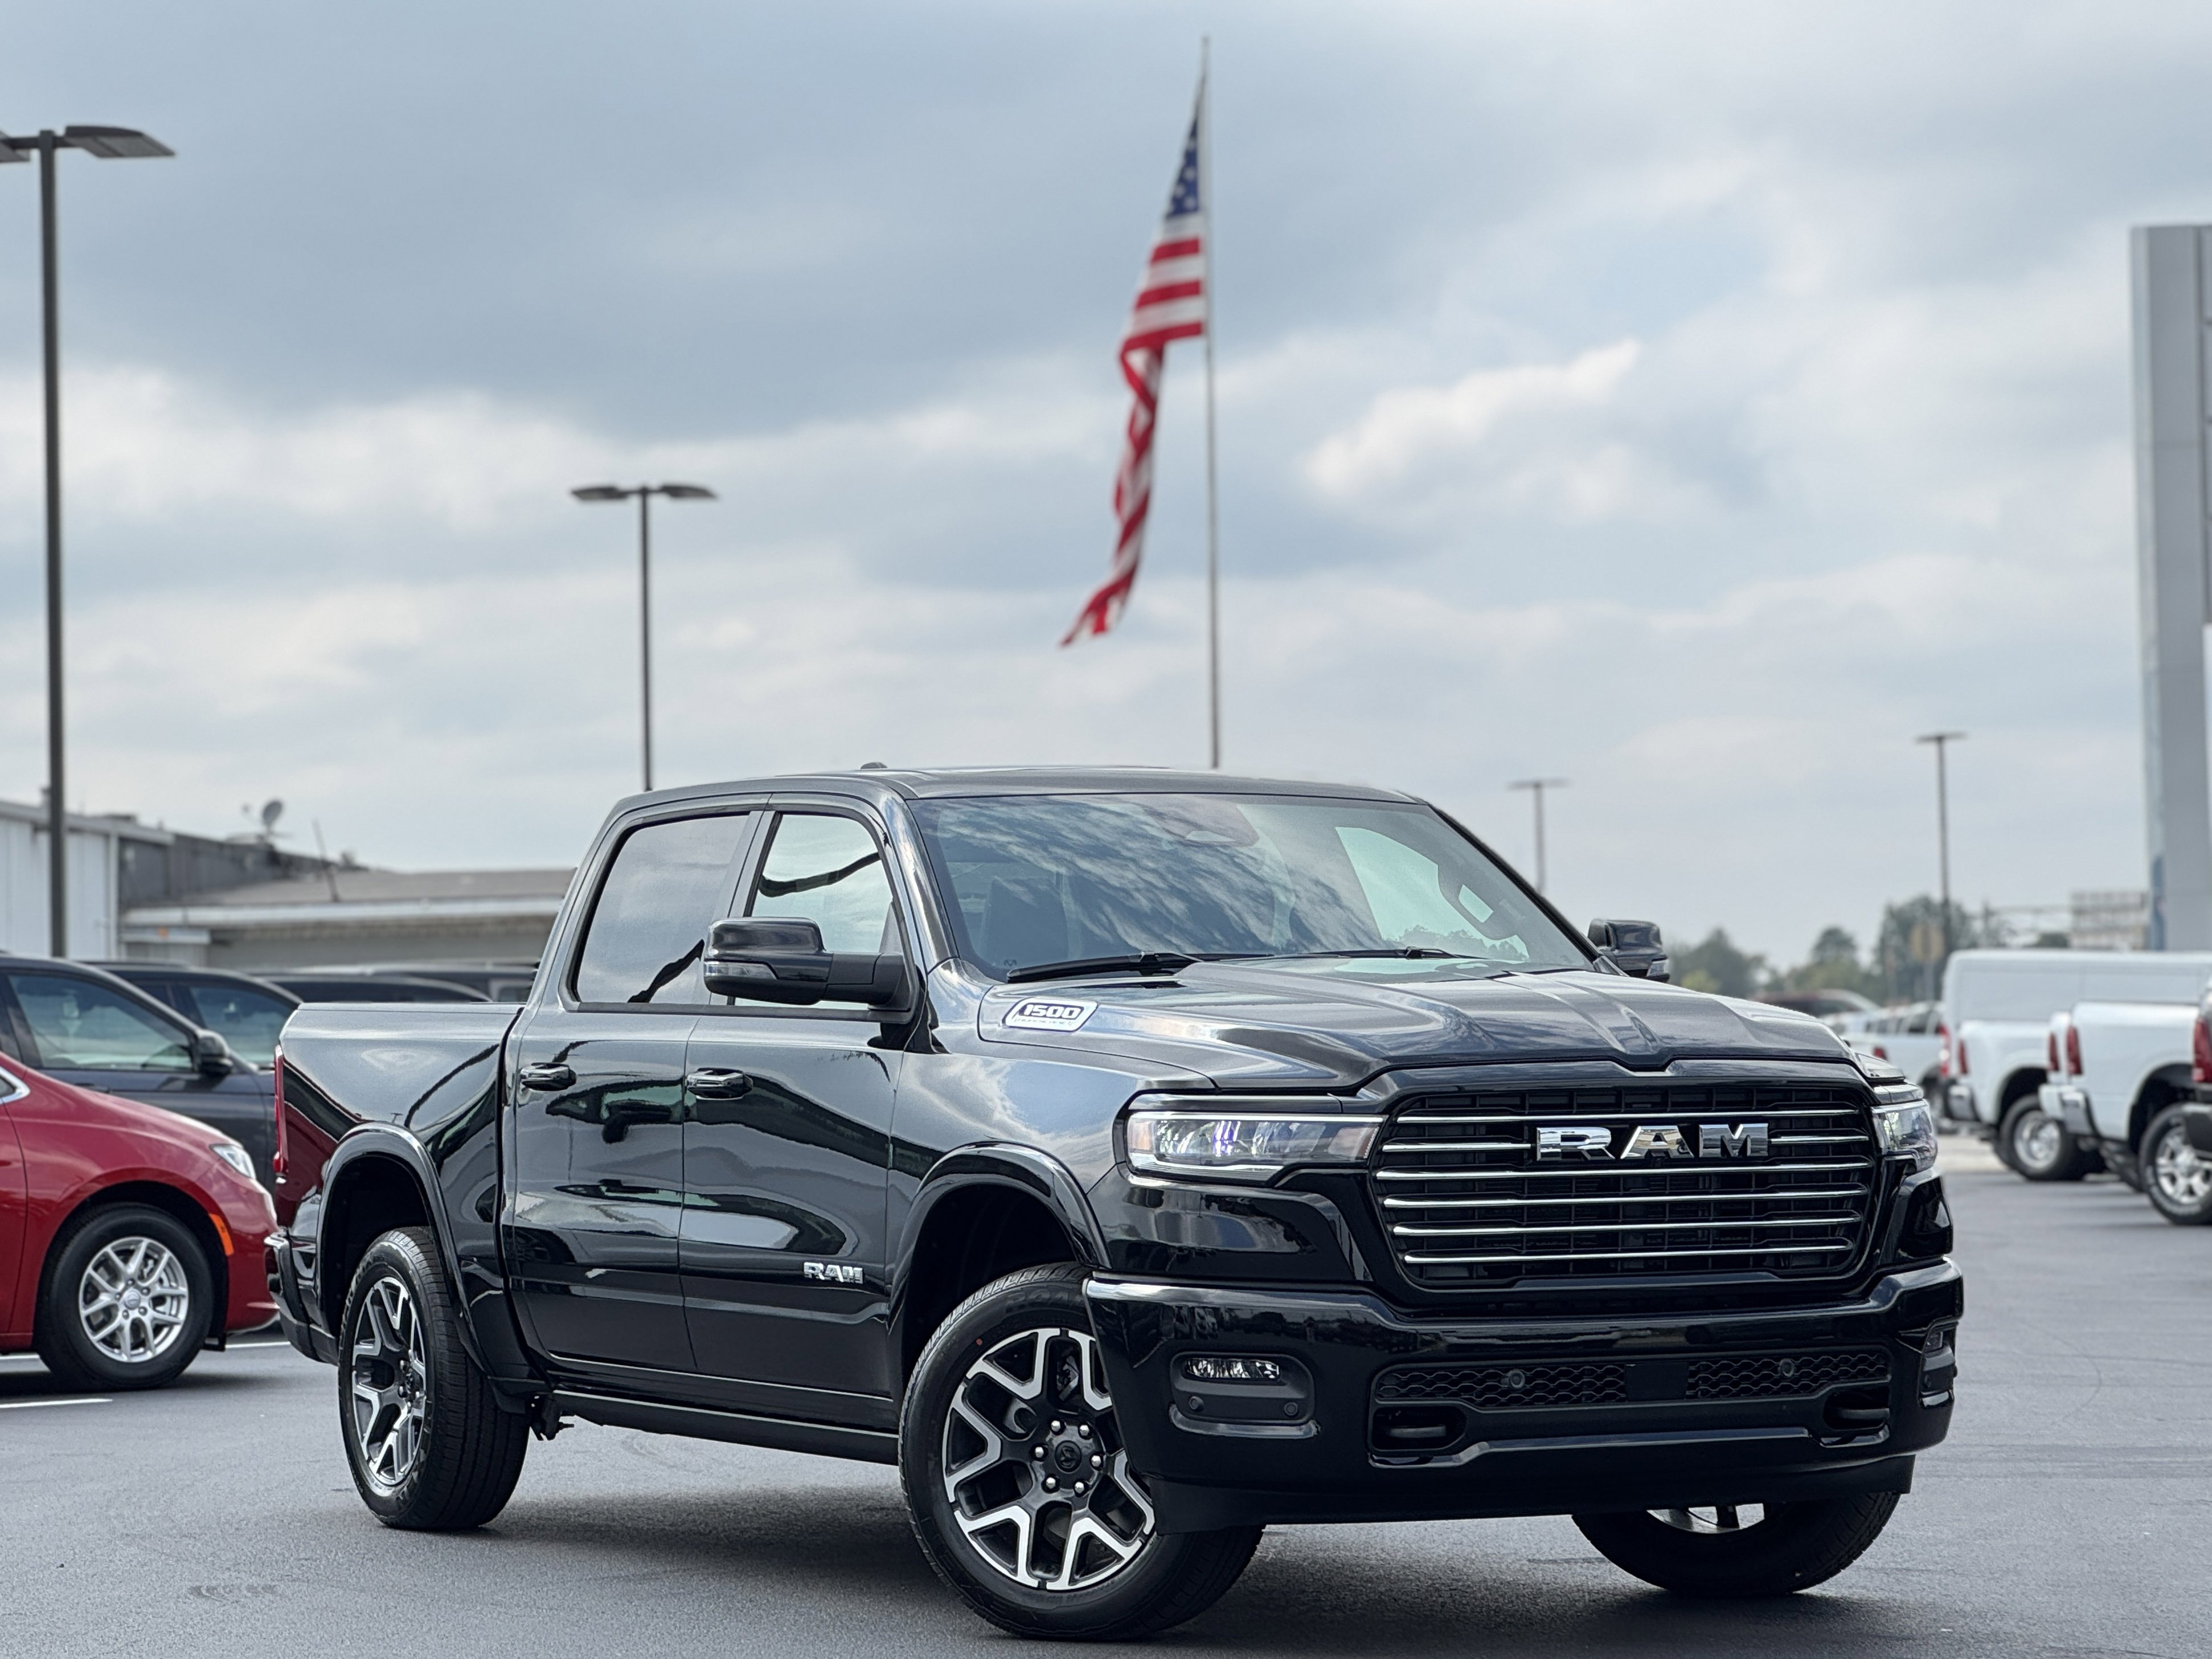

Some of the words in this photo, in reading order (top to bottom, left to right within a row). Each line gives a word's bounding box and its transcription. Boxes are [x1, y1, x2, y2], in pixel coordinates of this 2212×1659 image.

[1024, 1004, 1081, 1019] 1500
[1537, 1123, 1768, 1161] RAM
[804, 1261, 863, 1284] RAM
